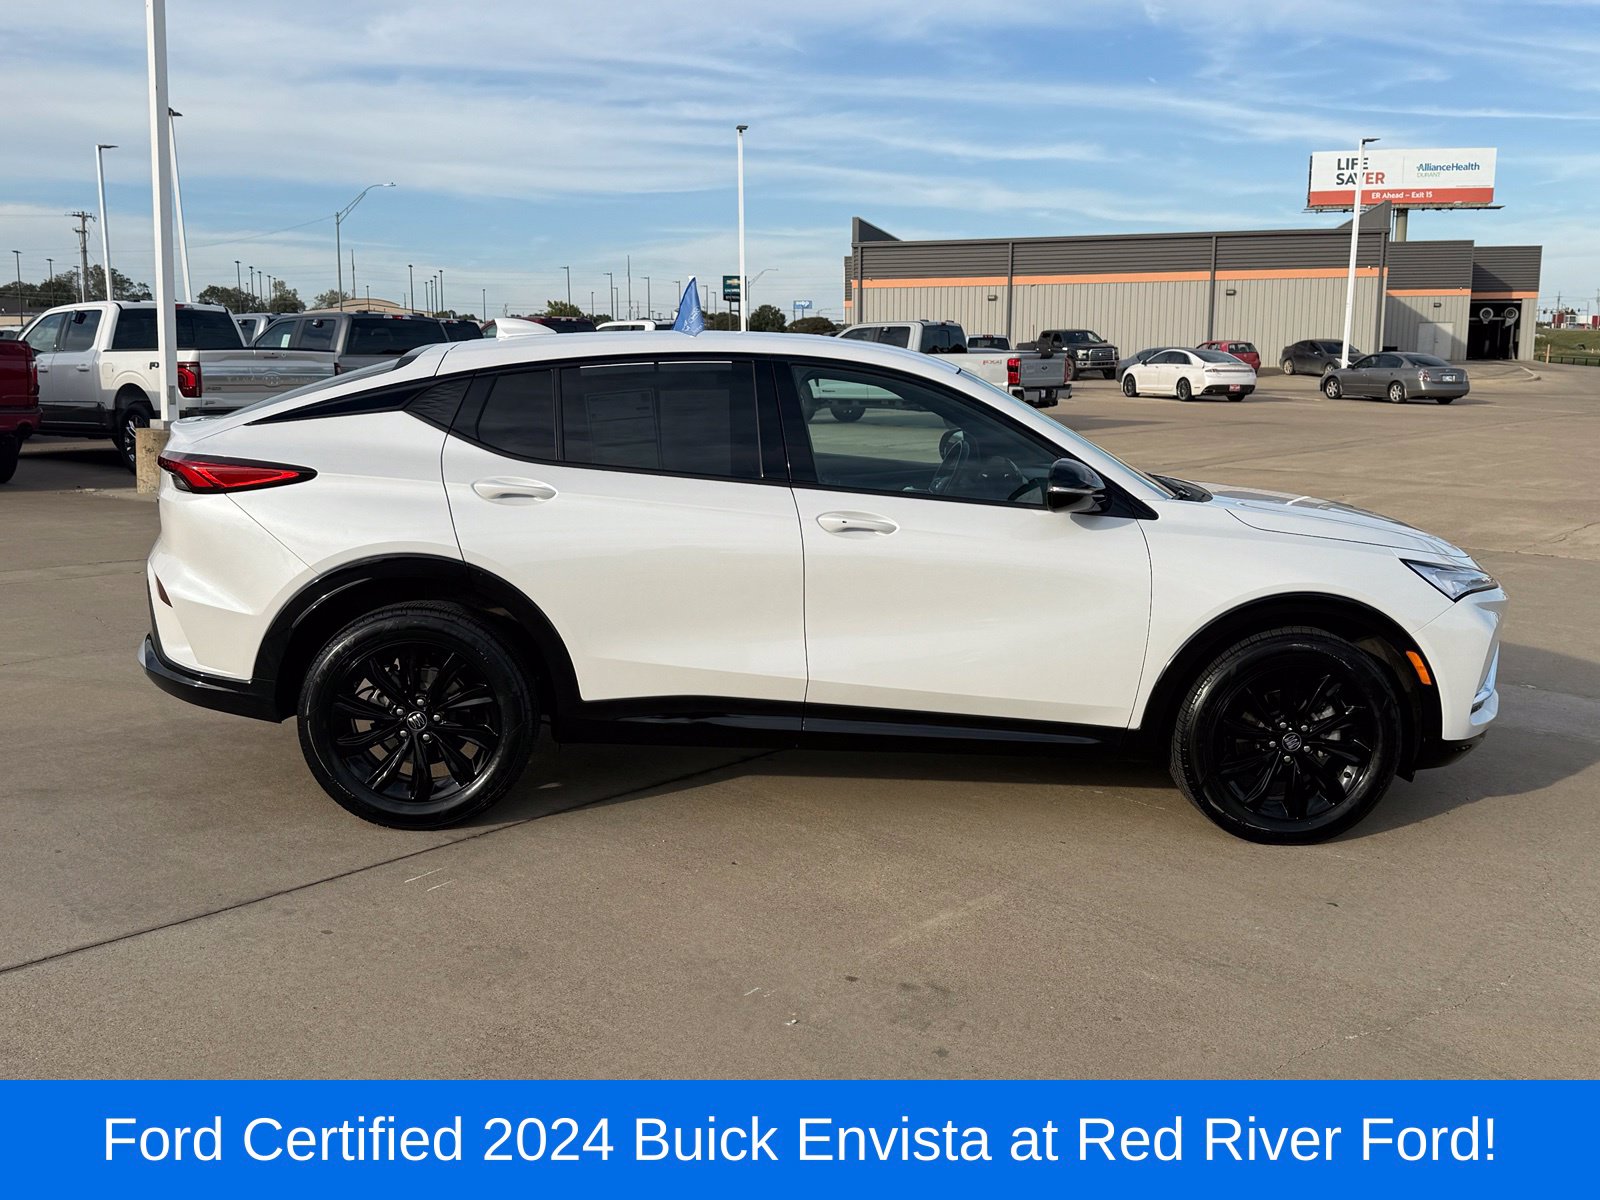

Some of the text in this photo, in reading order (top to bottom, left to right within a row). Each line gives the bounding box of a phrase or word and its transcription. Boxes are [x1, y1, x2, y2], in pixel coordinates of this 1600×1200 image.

[1337, 157, 1369, 171] LIFE
[1417, 162, 1480, 171] AllianceHealth
[1382, 191, 1404, 199] Ahead
[1411, 191, 1425, 199] Exit
[1425, 190, 1433, 198] 15
